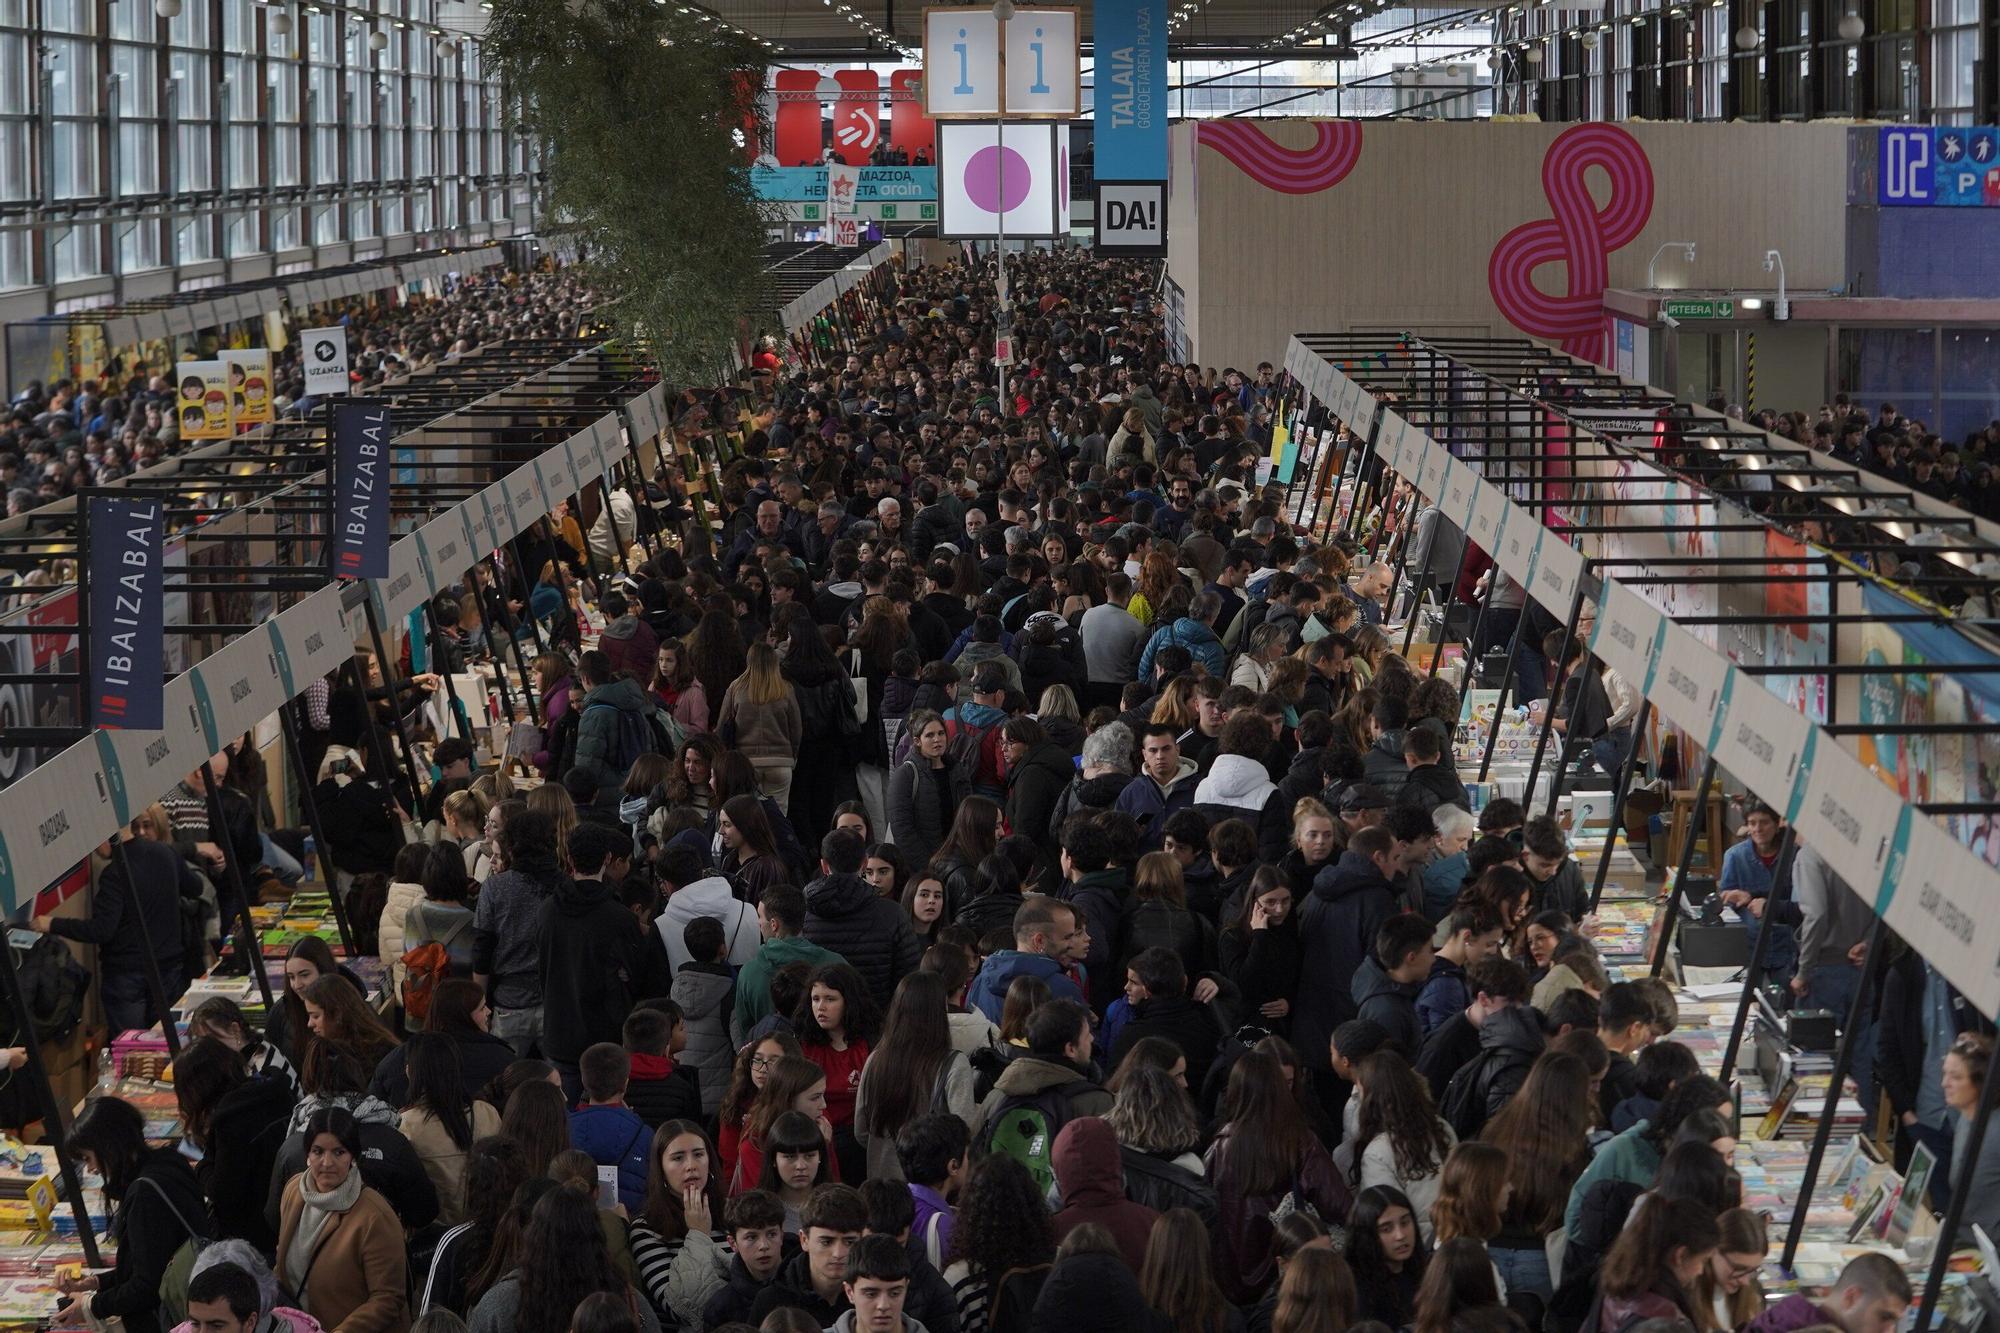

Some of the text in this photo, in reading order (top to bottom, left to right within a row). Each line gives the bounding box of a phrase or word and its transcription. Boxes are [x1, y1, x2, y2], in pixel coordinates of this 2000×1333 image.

[953, 28, 974, 95] i
[1030, 27, 1050, 94] i
[1111, 46, 1134, 129] TALAIA
[1137, 7, 1151, 129] GOGOETAREN PLAZA
[1887, 132, 1929, 199] 02
[836, 233, 858, 246] NIZ
[838, 220, 857, 233] YA
[1106, 200, 1156, 231] DA!
[1668, 304, 1712, 315] IRTEERA
[309, 365, 346, 377] UZANZA
[344, 410, 385, 546] IBAIZABAL
[104, 504, 156, 686] IBAIZABAL
